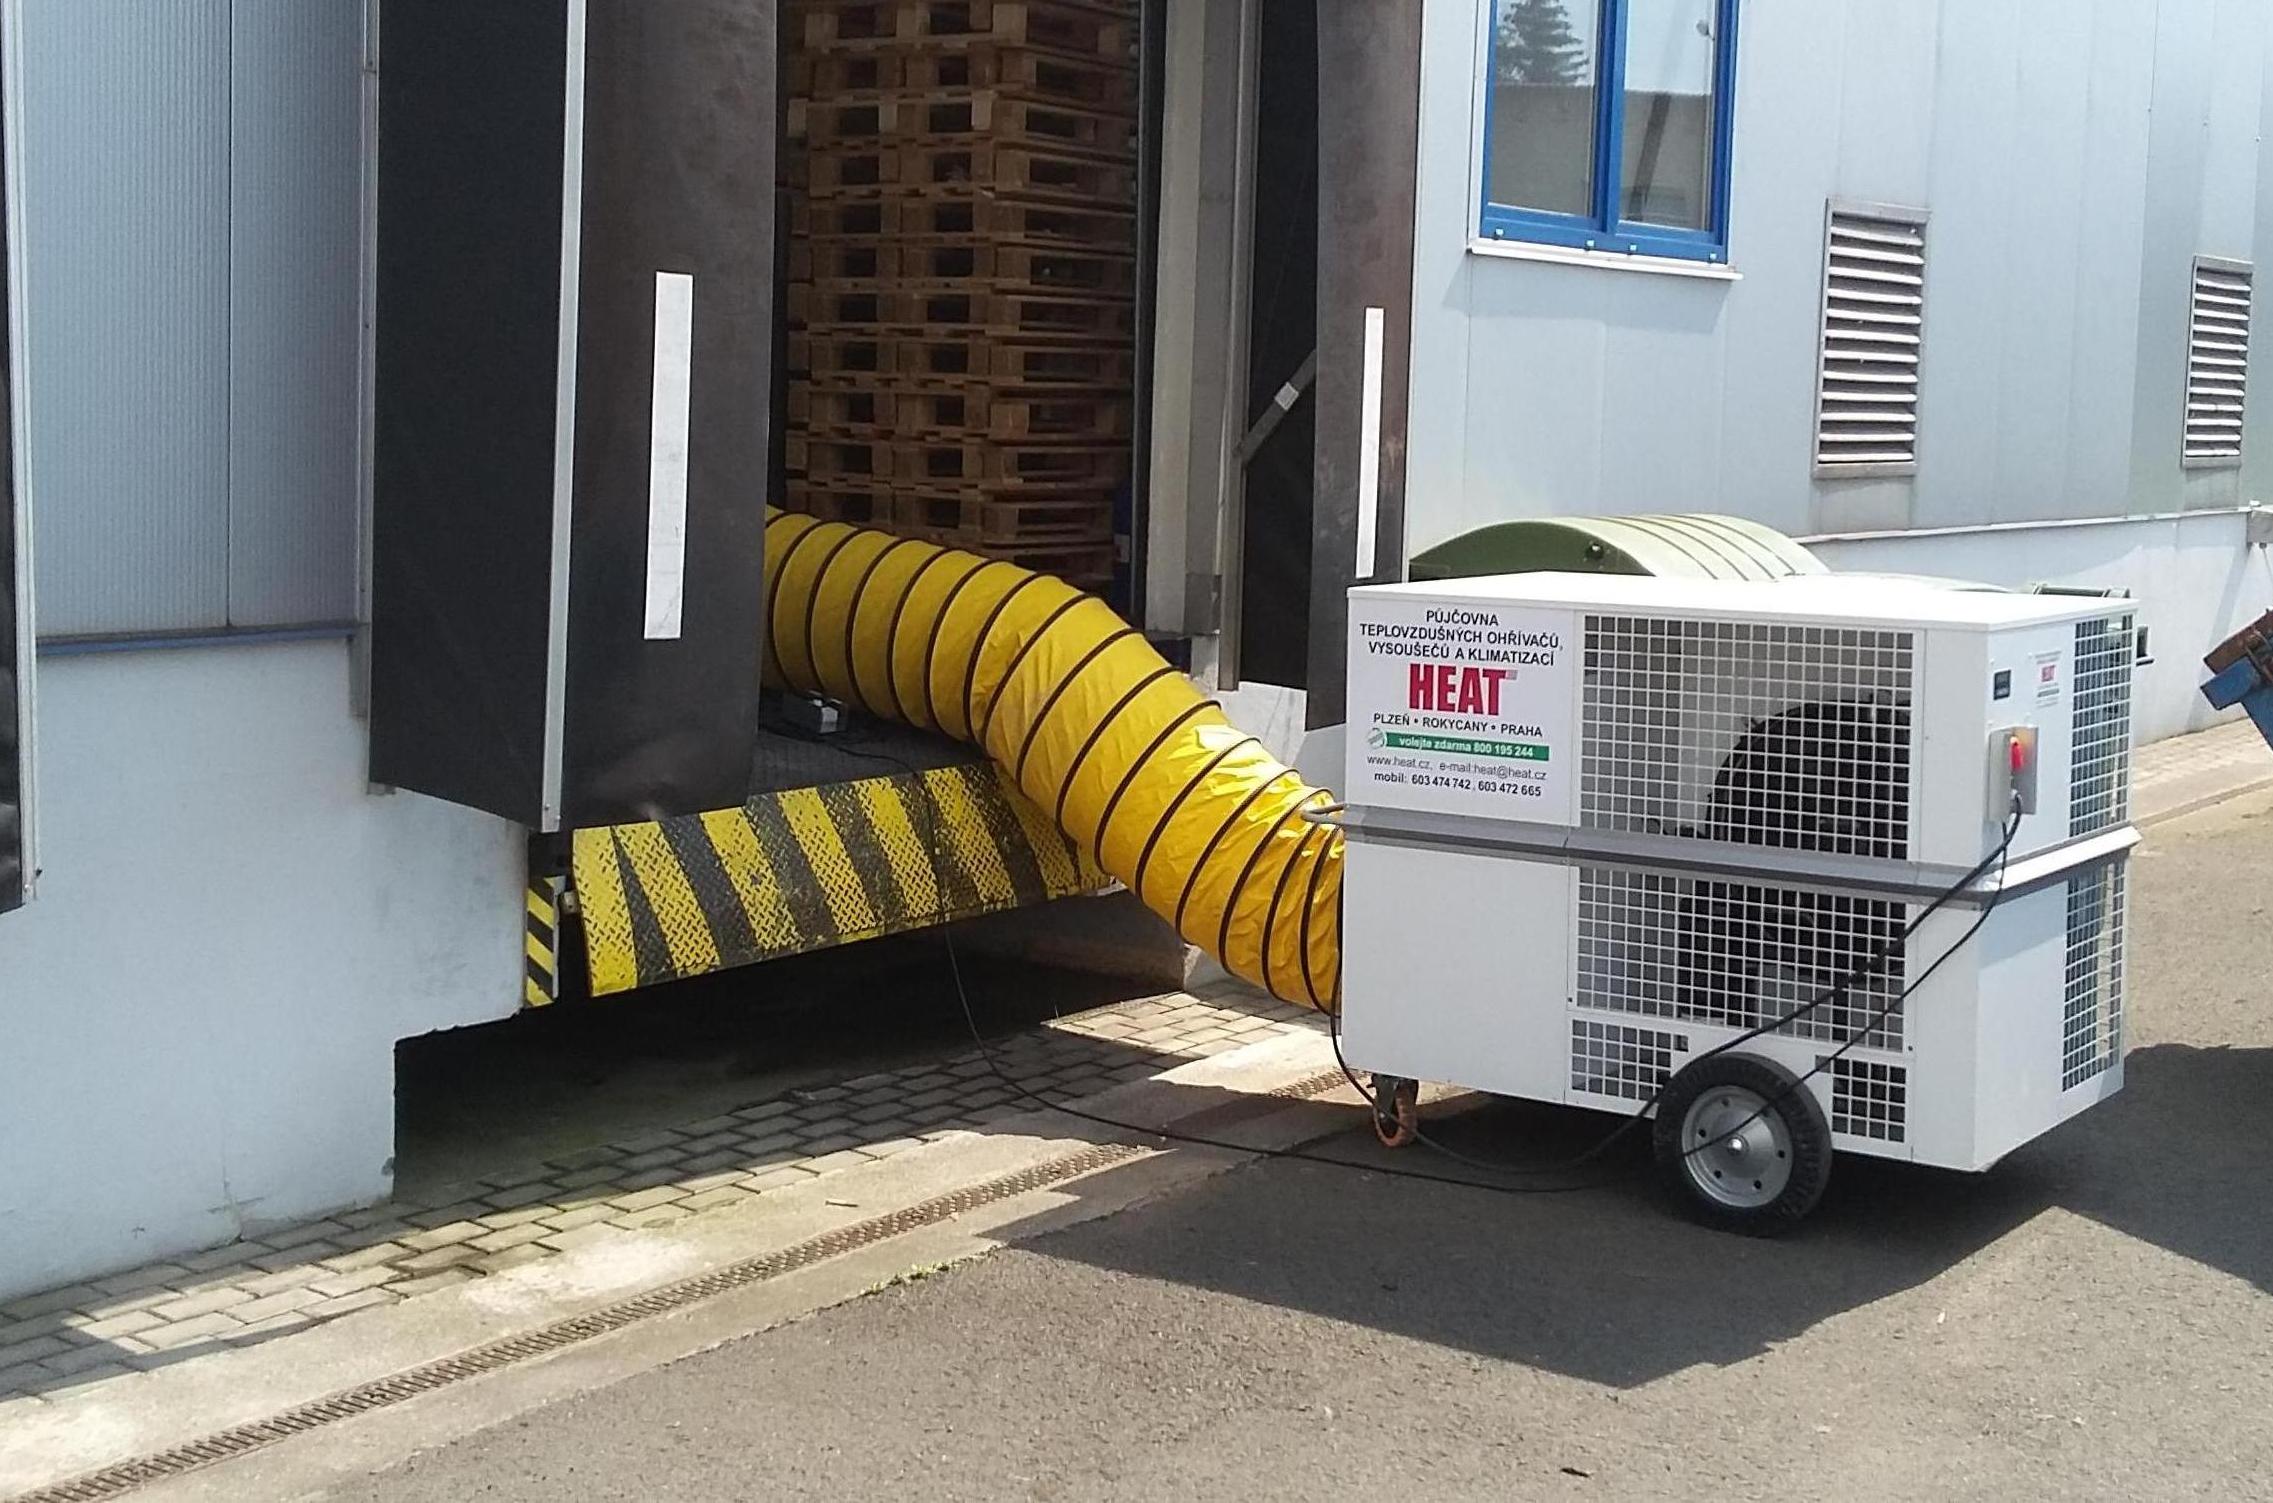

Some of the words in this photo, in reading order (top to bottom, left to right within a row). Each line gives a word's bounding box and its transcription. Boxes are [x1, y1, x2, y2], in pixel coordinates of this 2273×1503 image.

[1360, 623, 1482, 643] TEPLOVZDUŠNÝCH
[1369, 641, 1450, 659] VYSOUŠEČŮ
[1454, 647, 1465, 660] A
[1468, 647, 1554, 666] KLIMATIZACÍ
[1409, 663, 1507, 716] HEAT
[1374, 712, 1410, 726] PLZEŇ
[1422, 717, 1488, 732] ROKYCANY
[1500, 723, 1543, 737] PRAHA
[1399, 736, 1432, 750] volejte
[1433, 738, 1472, 752] zdarma
[1473, 741, 1492, 754] 800
[1495, 743, 1513, 756] 195
[1514, 746, 1534, 758] 244
[1374, 771, 1408, 784] mobil:
[1412, 774, 1431, 786] 603
[1432, 776, 1450, 788] 474
[1478, 780, 1497, 792] 603
[1499, 782, 1518, 794] 472
[1521, 785, 1542, 797] 665
